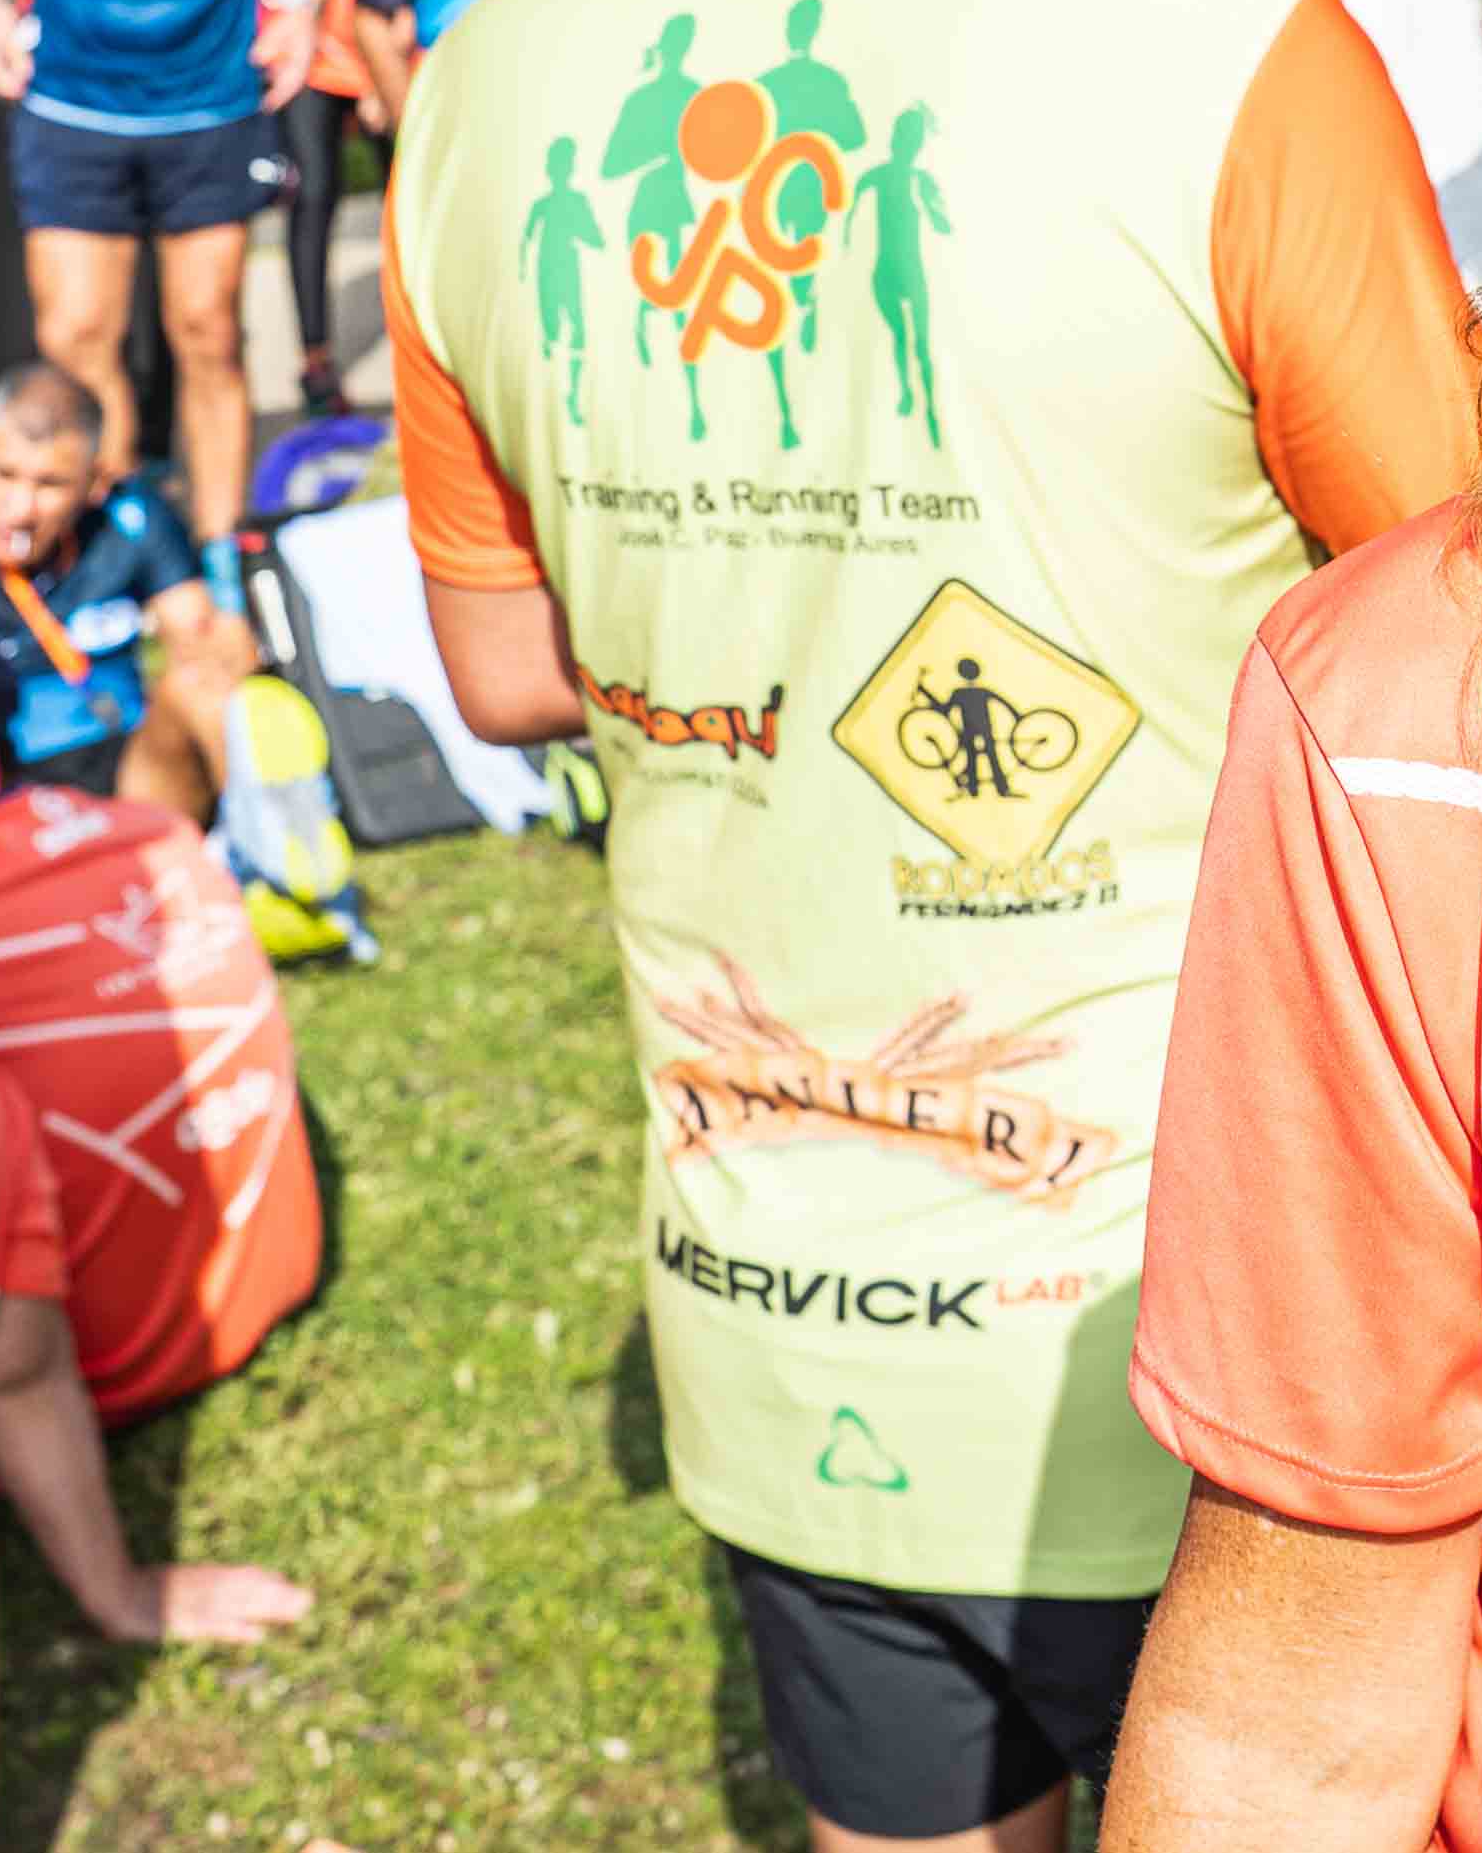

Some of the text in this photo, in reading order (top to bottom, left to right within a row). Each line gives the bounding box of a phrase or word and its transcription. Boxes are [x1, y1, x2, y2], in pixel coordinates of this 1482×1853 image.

[729, 478, 860, 527] Running
[870, 484, 980, 522] Team
[656, 1216, 1086, 1329] MERVICK LAB
